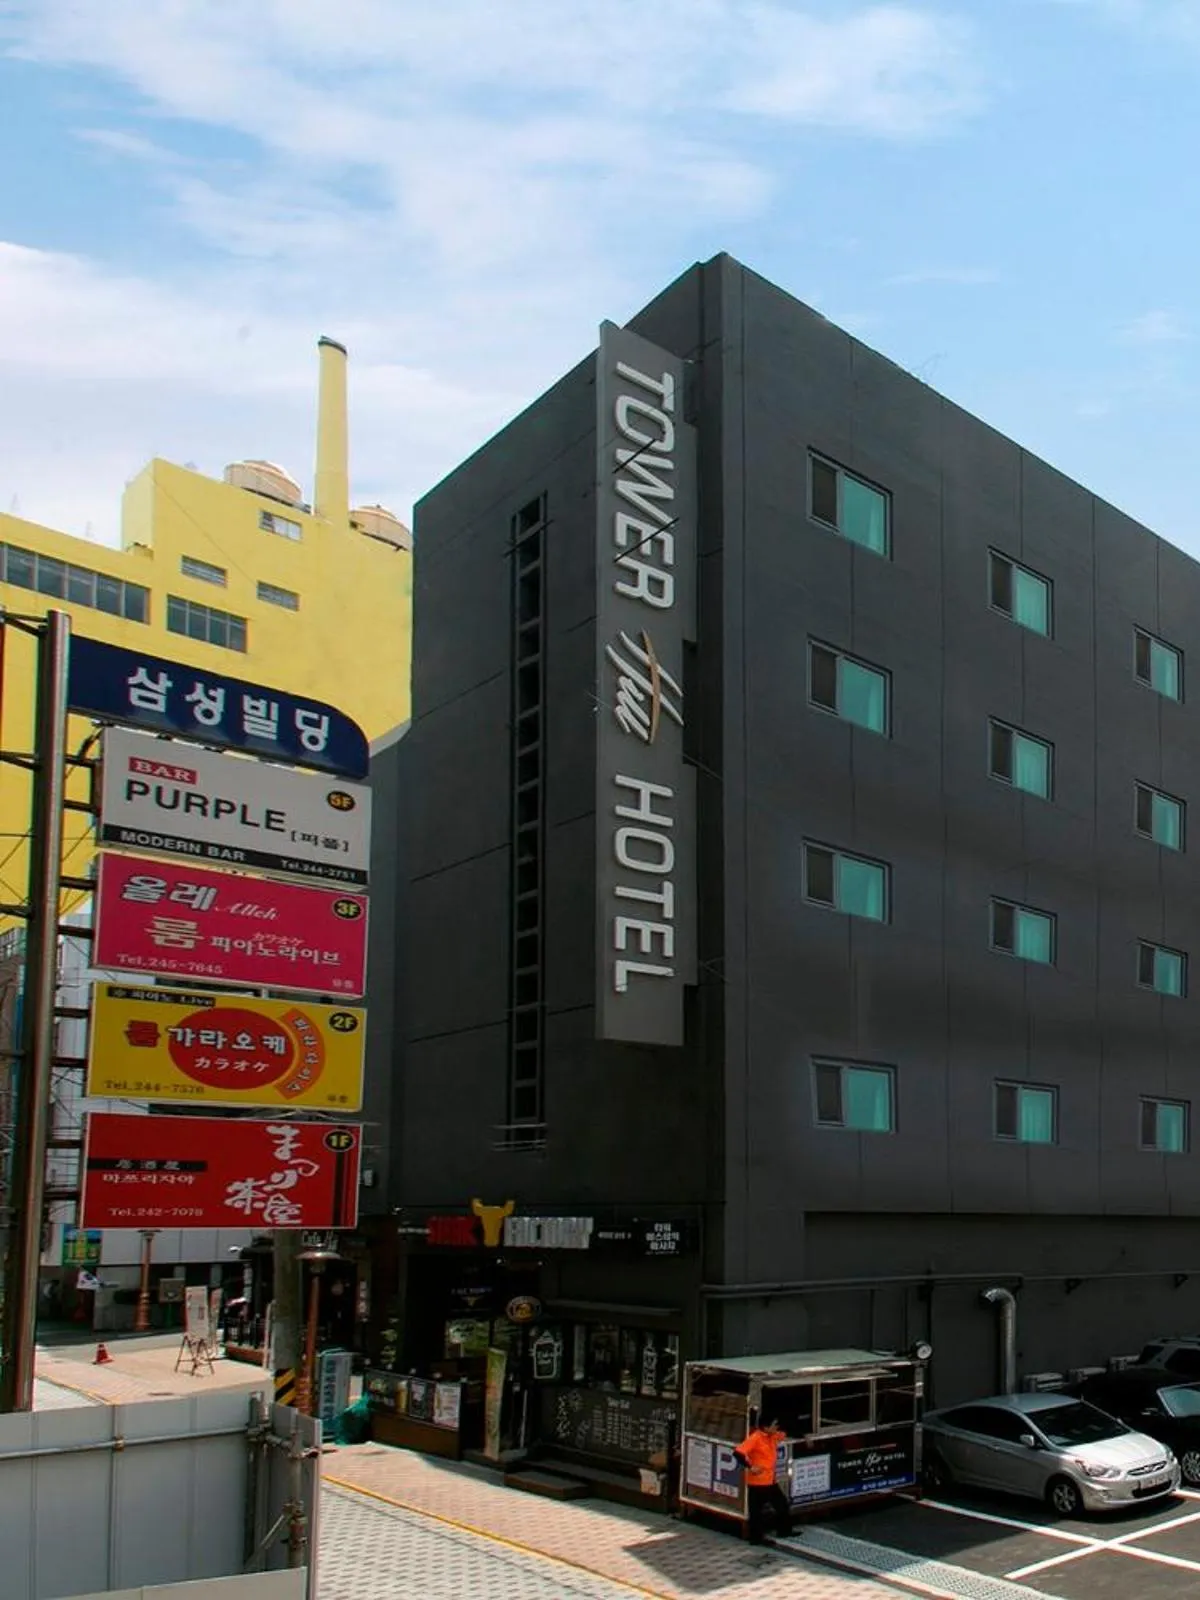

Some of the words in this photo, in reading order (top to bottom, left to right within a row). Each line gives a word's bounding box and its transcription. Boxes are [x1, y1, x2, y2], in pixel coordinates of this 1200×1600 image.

[612, 361, 675, 609] TOWER
[127, 666, 330, 752] 삼성빌딩
[133, 761, 194, 782] BAR
[126, 779, 287, 834] PURPLE
[121, 831, 200, 855] MODERN
[208, 844, 246, 862] BAR
[122, 874, 218, 912] 올레
[612, 773, 675, 993] HOTEL
[337, 902, 360, 916] 3F
[211, 935, 341, 966] 피아노라이브
[333, 1015, 354, 1029] 2F
[168, 1027, 286, 1055] 가라오케
[194, 1057, 269, 1072] カラオケ
[329, 1135, 350, 1147] 1F
